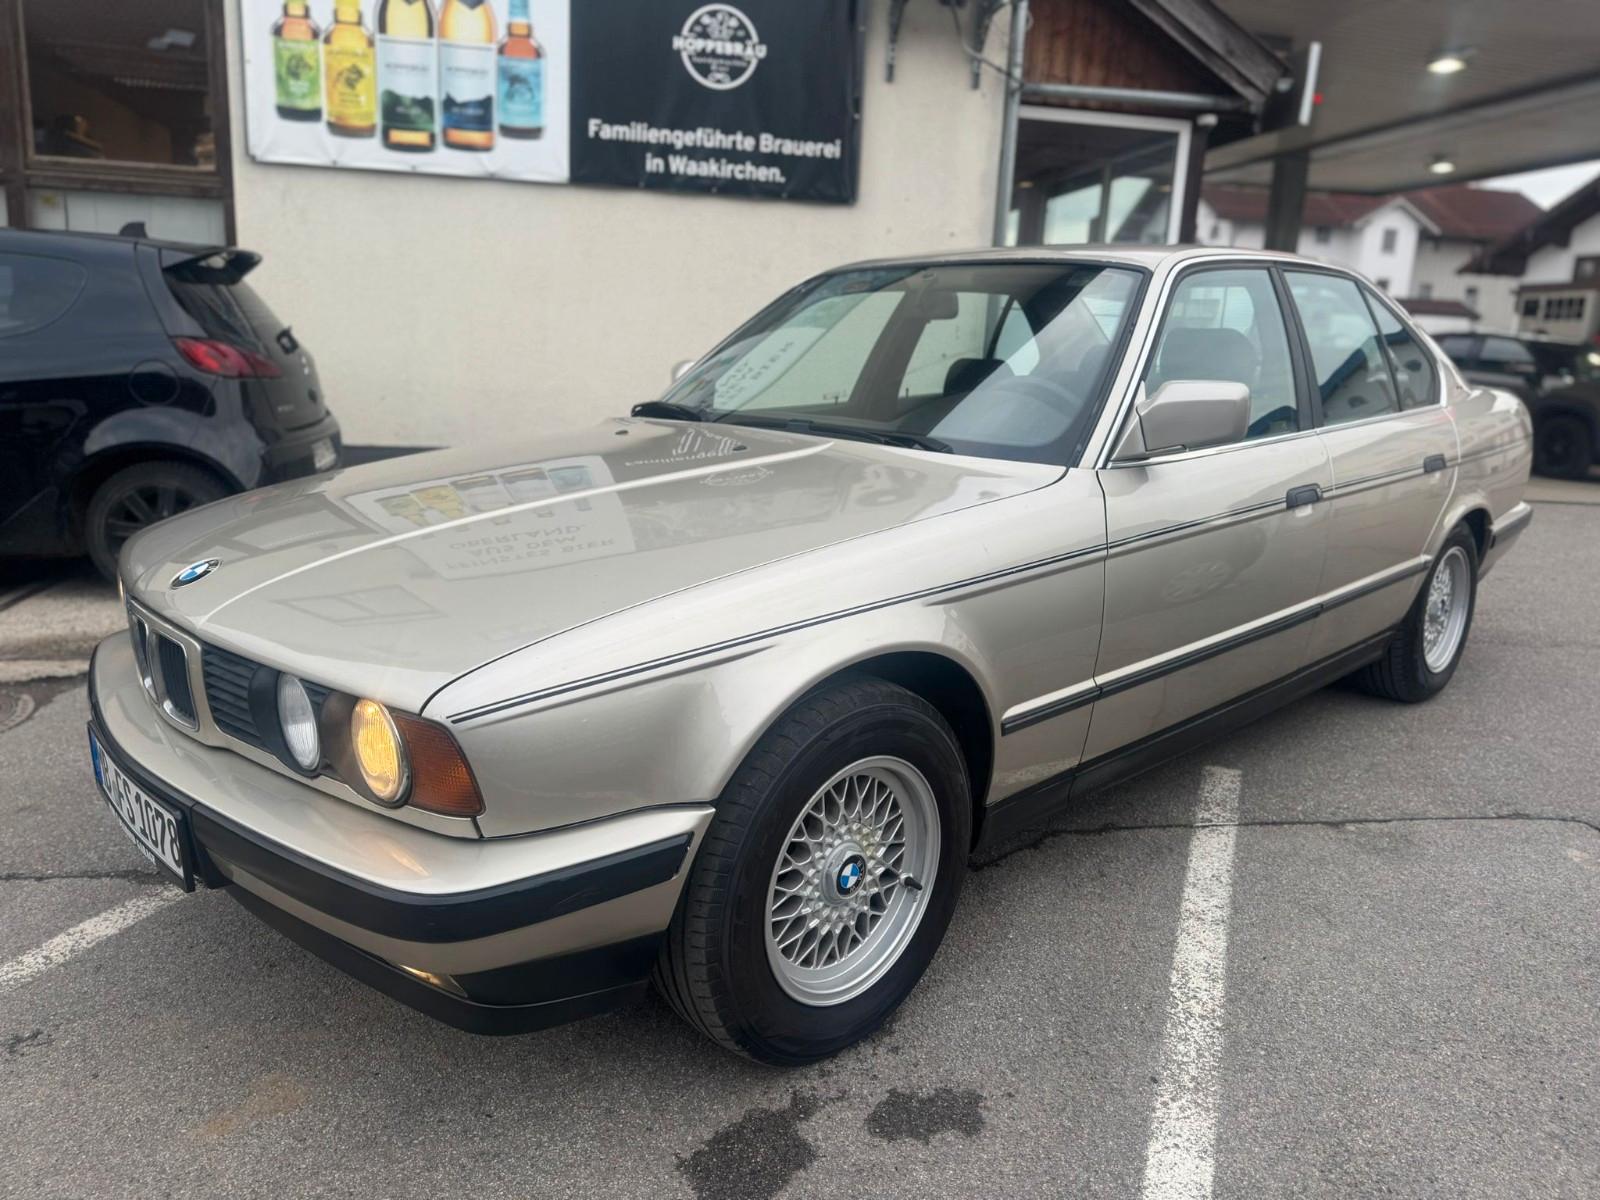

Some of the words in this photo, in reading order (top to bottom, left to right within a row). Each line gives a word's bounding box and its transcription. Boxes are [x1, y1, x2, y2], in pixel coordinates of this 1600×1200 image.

[587, 118, 756, 152] Familiengeführte
[759, 133, 842, 160] Brauerei
[645, 153, 665, 174] in
[668, 154, 787, 184] Waakirchen.
